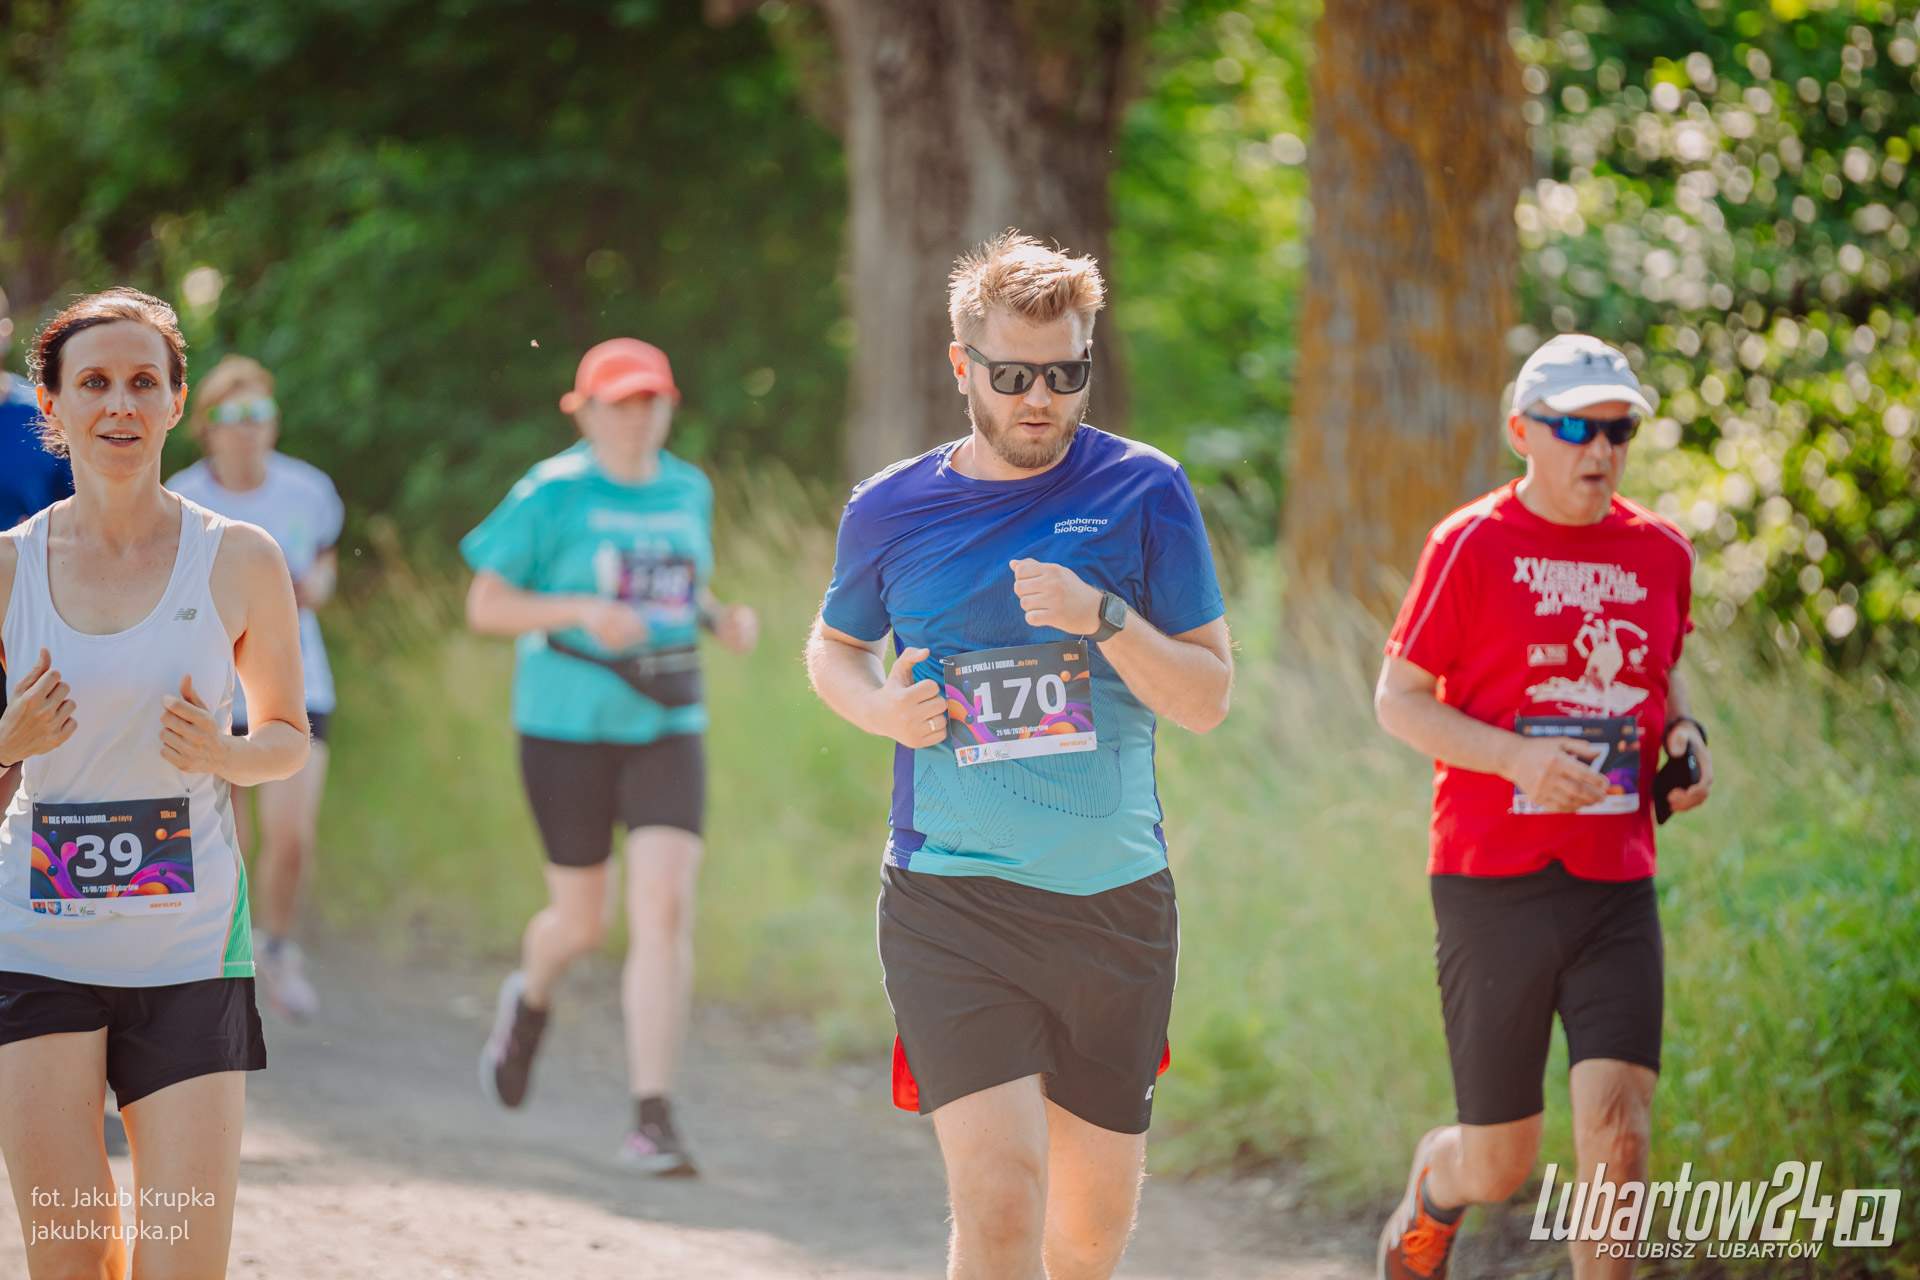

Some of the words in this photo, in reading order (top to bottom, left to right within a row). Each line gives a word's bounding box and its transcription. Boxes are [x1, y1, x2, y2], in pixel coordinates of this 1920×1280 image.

[1054, 525, 1098, 534] biologics
[1055, 517, 1108, 528] polpharma
[973, 674, 1067, 723] 170
[76, 833, 143, 878] 39
